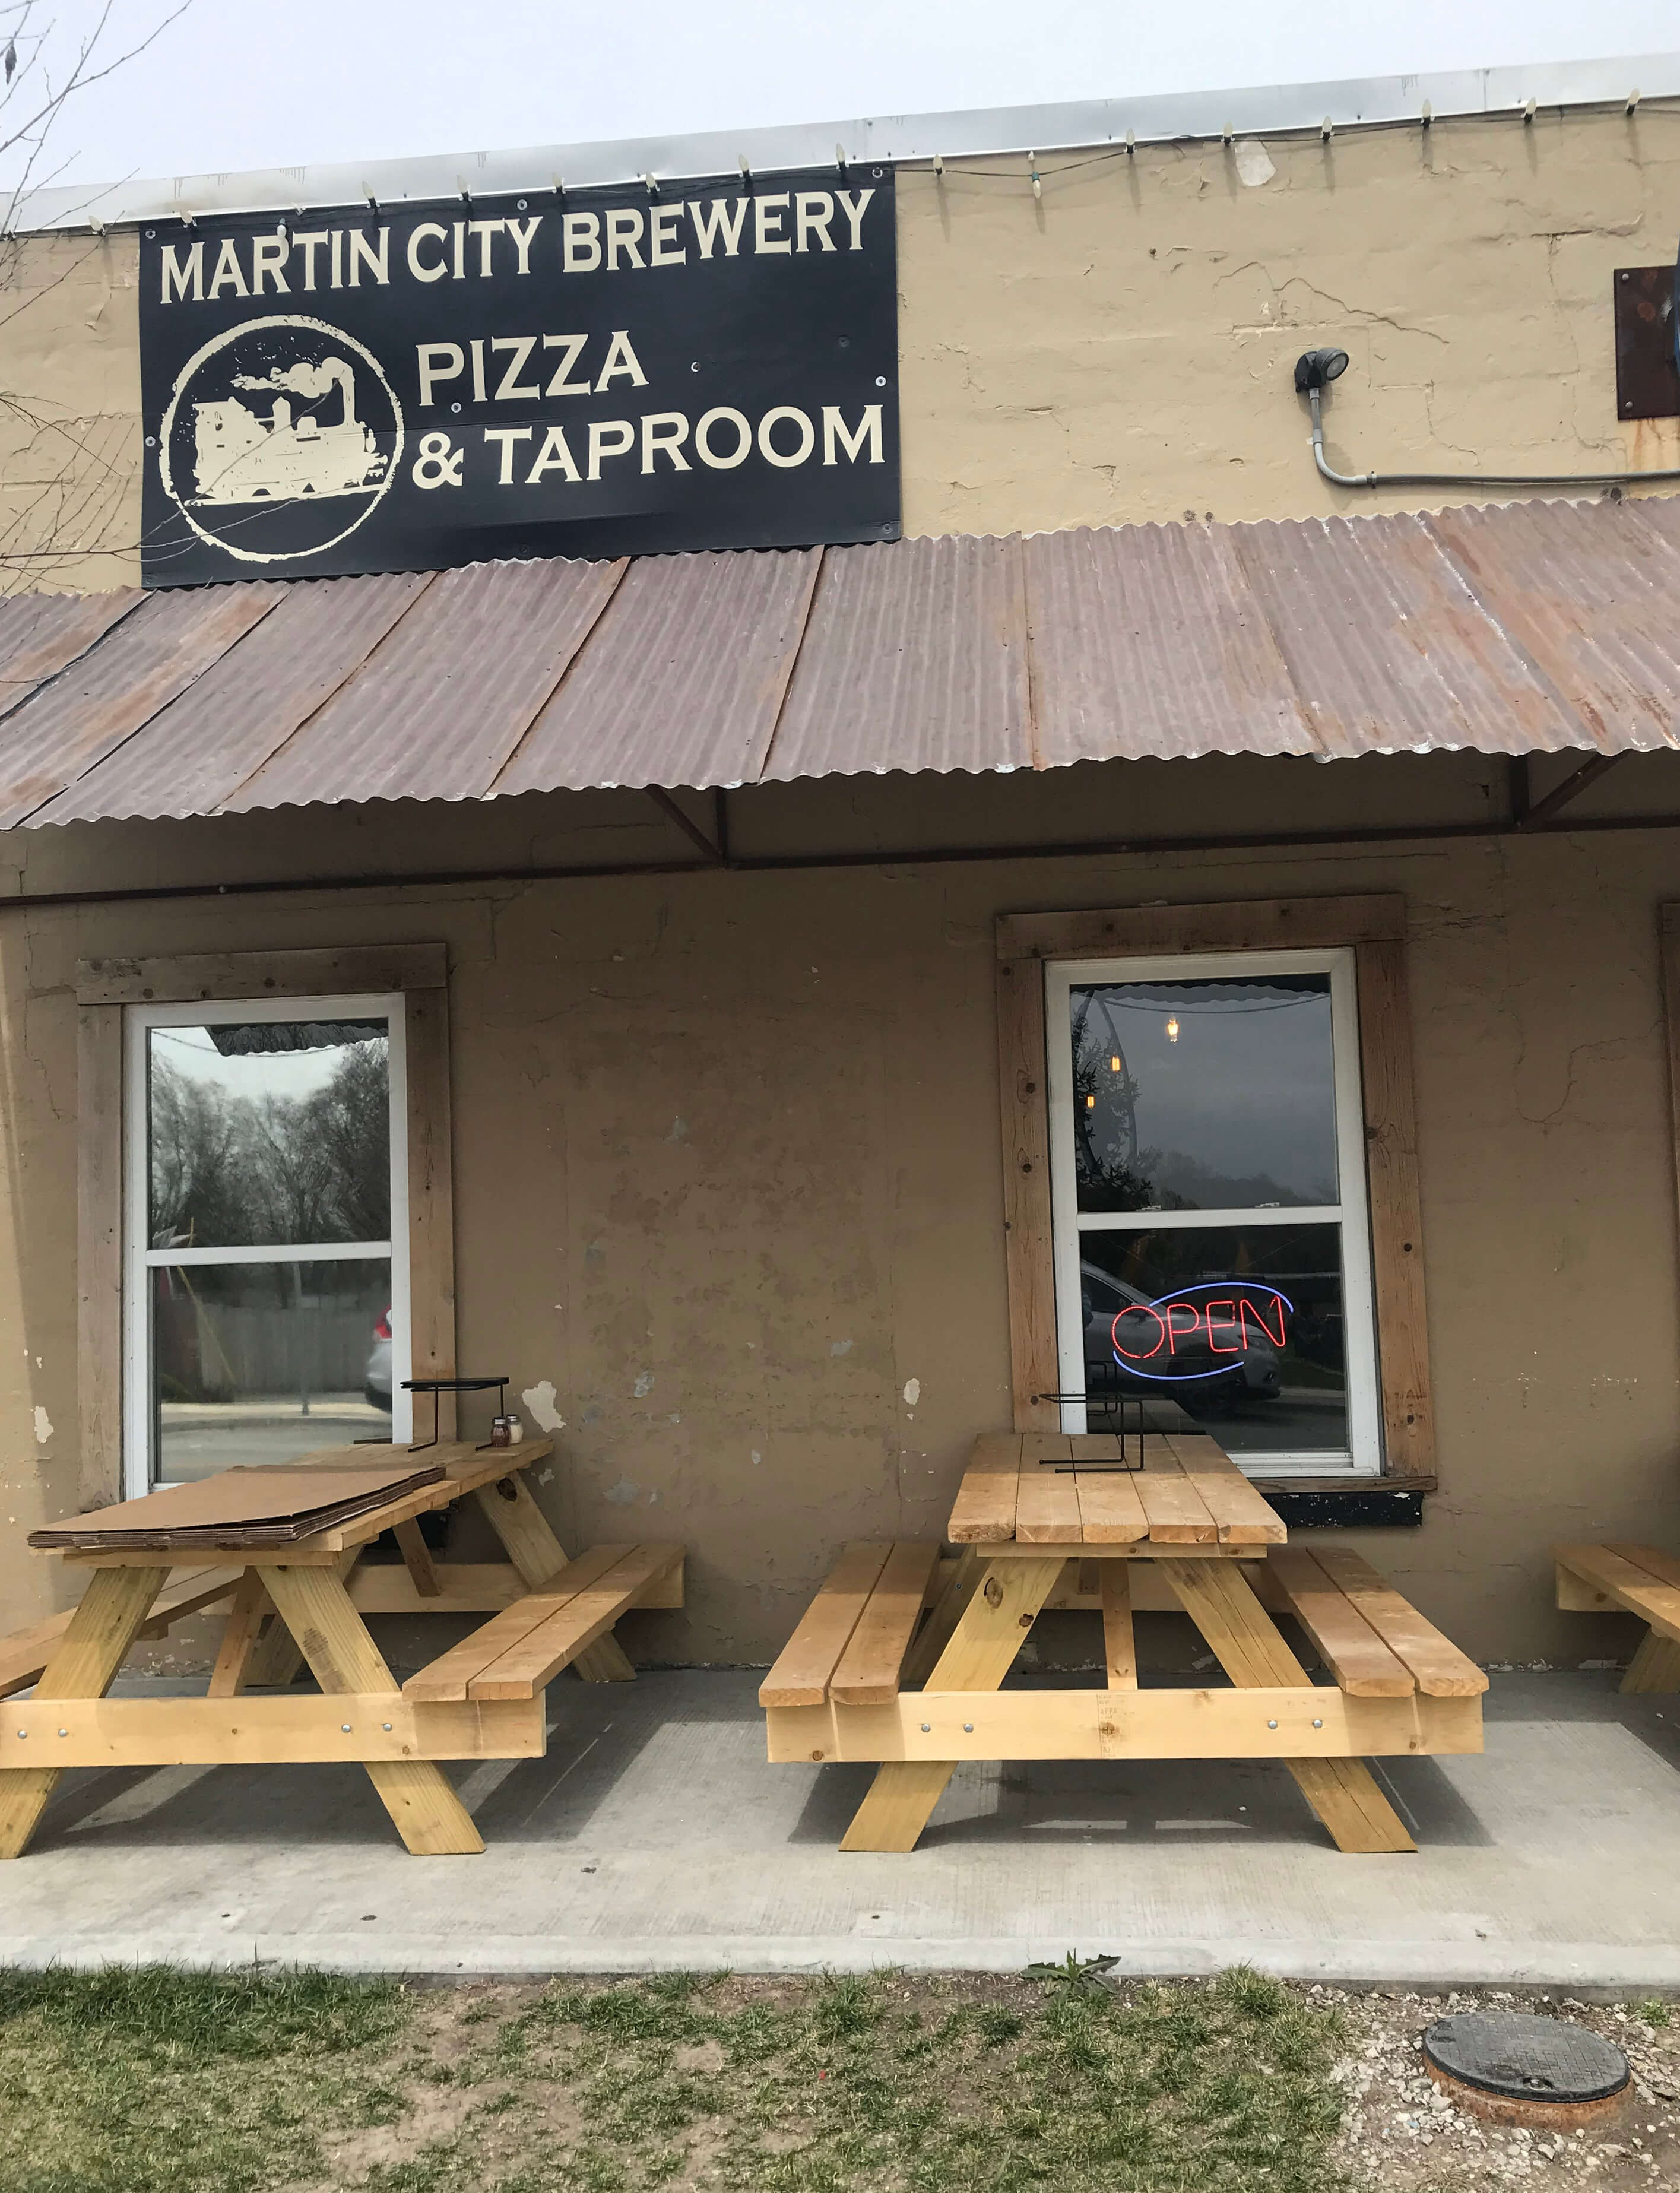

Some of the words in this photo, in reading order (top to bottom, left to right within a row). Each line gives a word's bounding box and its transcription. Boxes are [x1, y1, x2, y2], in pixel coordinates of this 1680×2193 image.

[160, 227, 390, 304] MARTIN
[407, 216, 543, 282] CITY
[562, 189, 875, 272] BREWERY
[416, 331, 649, 406] PIZZA
[413, 432, 464, 489] &
[484, 405, 885, 484] TAPROOM
[1112, 1297, 1285, 1358] OPEN
